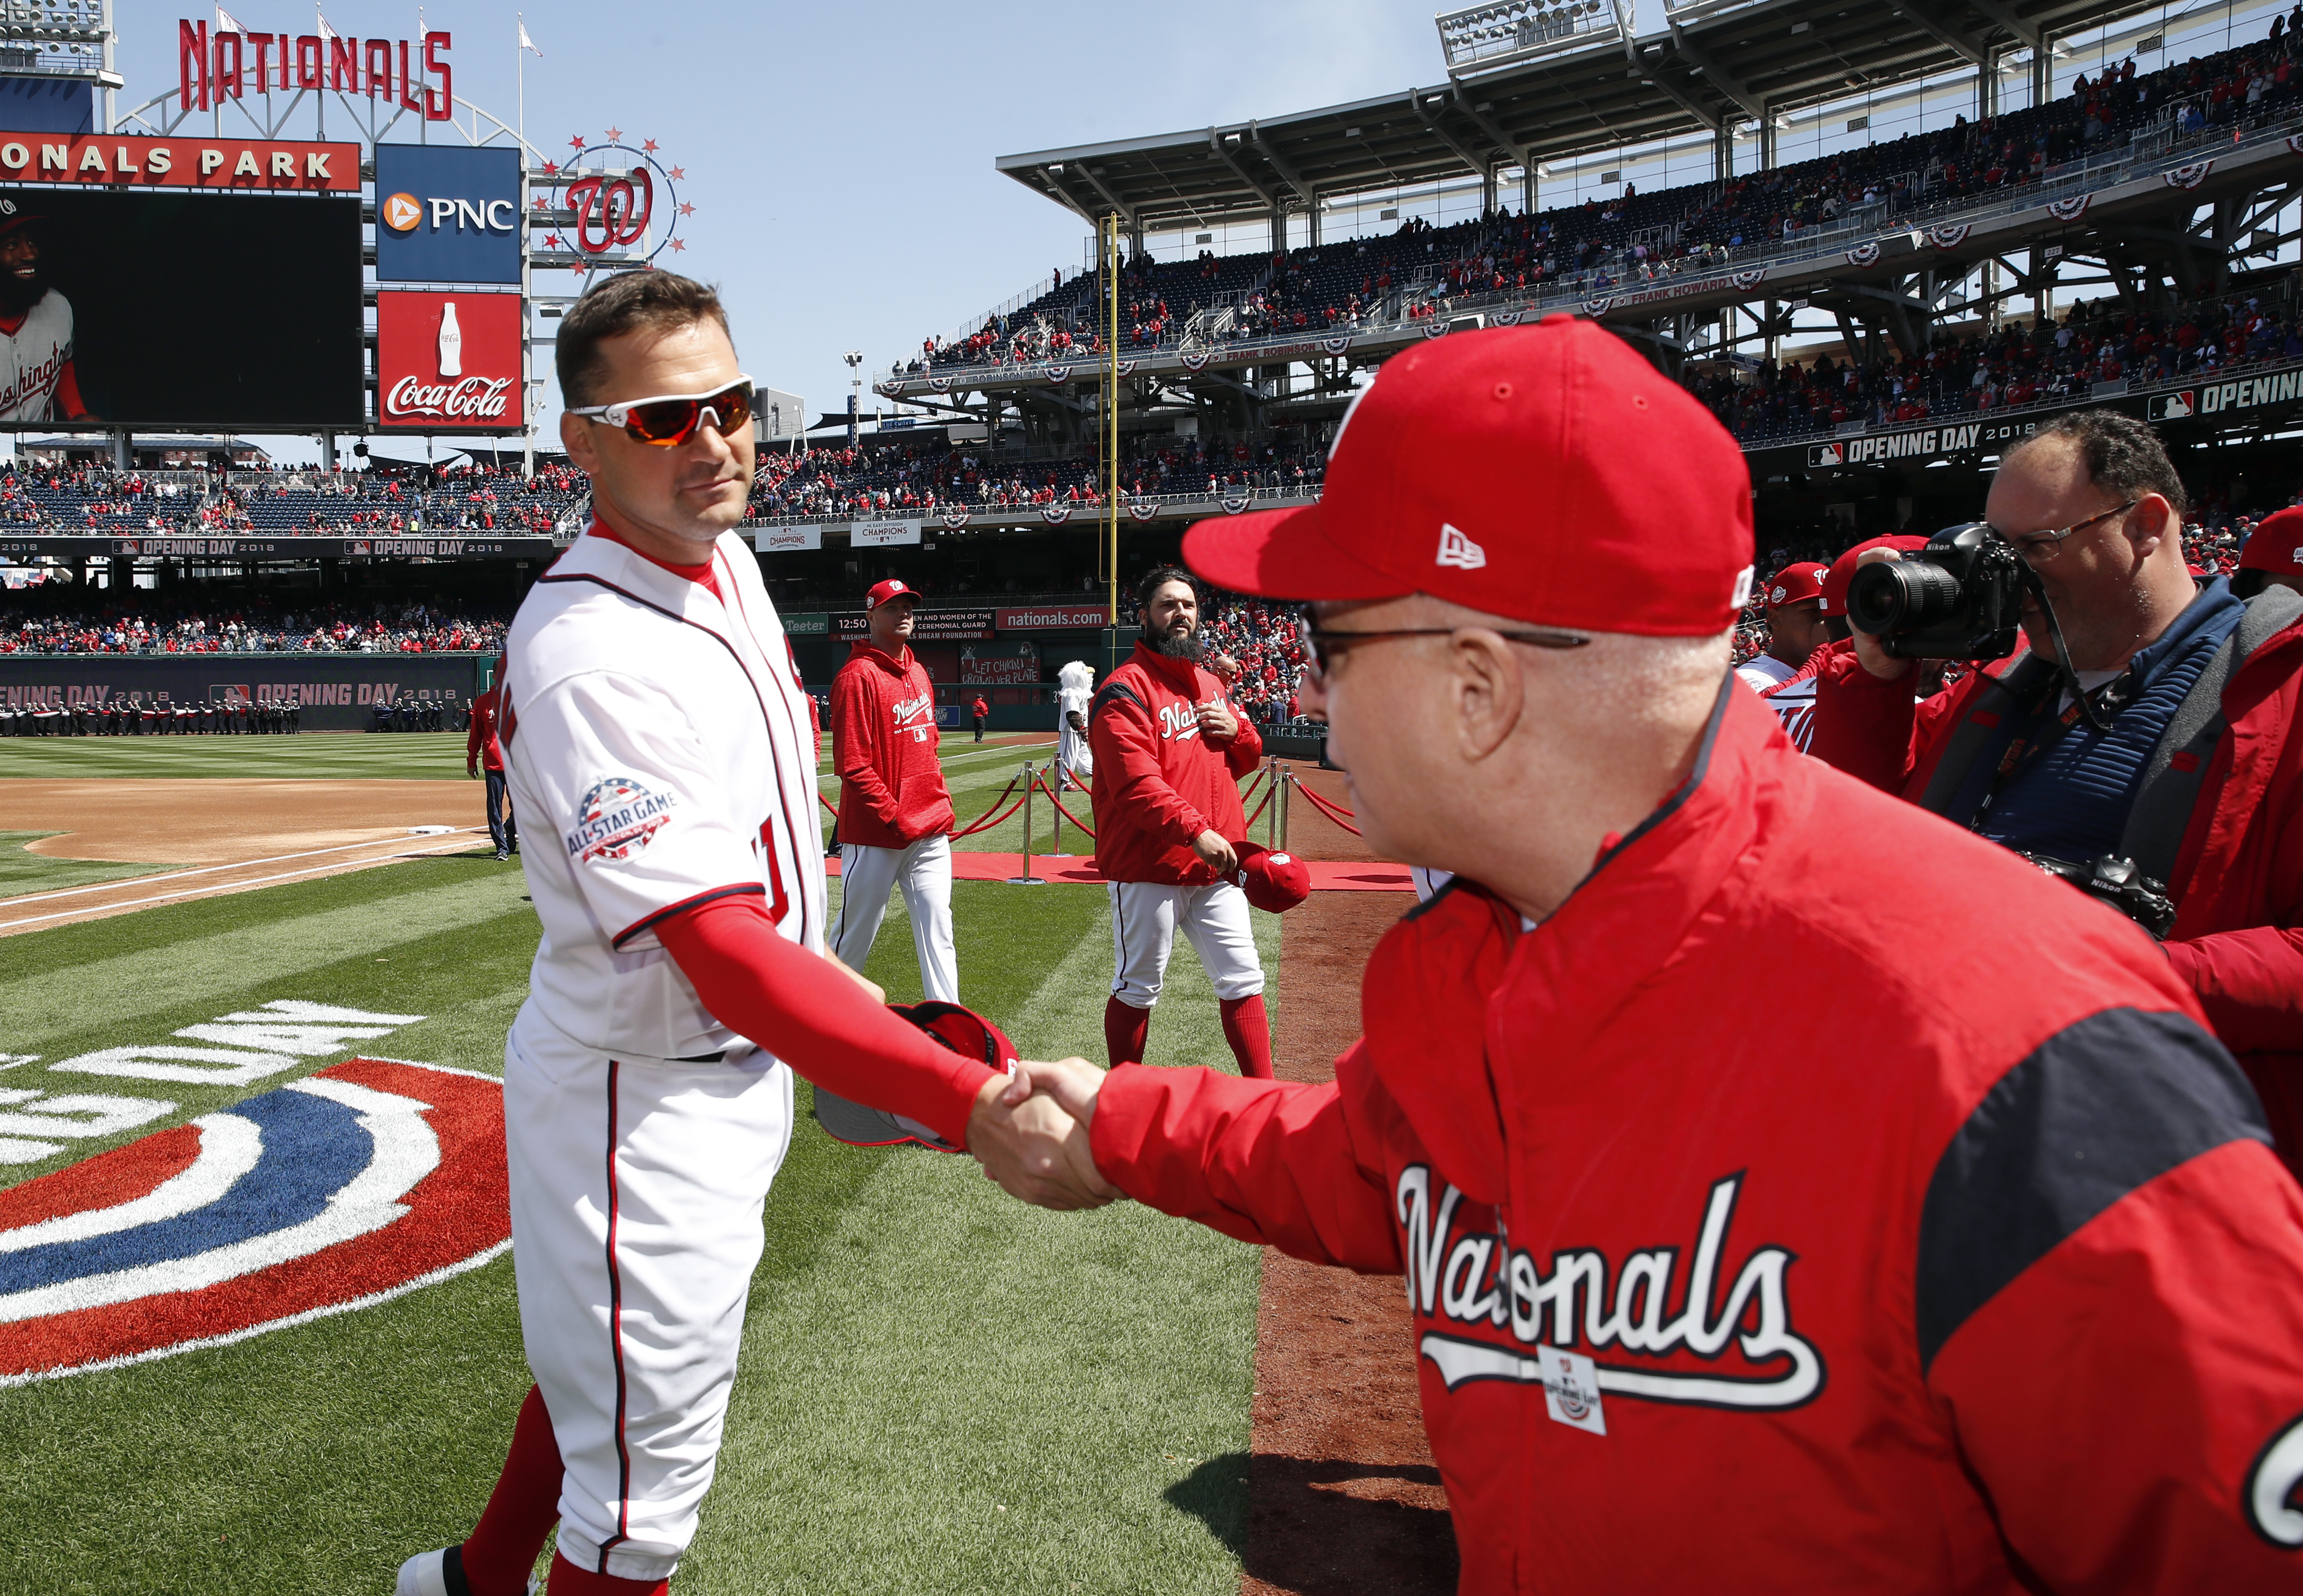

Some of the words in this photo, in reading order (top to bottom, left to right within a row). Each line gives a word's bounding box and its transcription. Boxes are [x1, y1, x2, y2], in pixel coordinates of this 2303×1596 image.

[2143, 40, 2158, 50] 226
[179, 19, 452, 121] NATIONALS
[1852, 120, 1865, 128] 228
[1, 142, 172, 174] ONALS
[202, 149, 332, 178] PARK
[428, 198, 514, 230] PNC
[2047, 247, 2060, 256] 227
[1632, 288, 1670, 305] FRANK
[1675, 279, 1727, 295] HOWARD
[1227, 349, 1259, 361] FRANK
[1264, 343, 1316, 356] ROBINSON
[973, 371, 1023, 383] ROBINSON
[387, 375, 514, 416] Coca-Cola
[894, 420, 913, 428] SMOKE
[1848, 430, 1937, 463] OPENING
[1941, 424, 1982, 451] DAY
[1986, 423, 2036, 440] 2018
[862, 527, 907, 536] CHAMPIONS
[144, 540, 206, 555] OPENING
[209, 540, 235, 555] DAY
[374, 541, 436, 555] OPENING
[438, 541, 465, 555] DAY
[770, 536, 805, 546] CHAMPIONS
[786, 619, 825, 631] Teeter
[839, 619, 866, 629] 12:50
[1008, 611, 1102, 627] nationals.com
[975, 662, 991, 675] LET
[962, 673, 994, 684] CROWD
[997, 674, 1010, 684] YER
[1013, 669, 1038, 684] PLATE
[67, 685, 110, 708] DAY
[115, 691, 170, 701] 2018
[257, 683, 352, 706] OPENING
[357, 683, 399, 706] DAY
[403, 689, 456, 700] 2018
[892, 688, 931, 725] Nationals
[633, 792, 677, 820] GAME
[2091, 879, 2122, 892] Nikon
